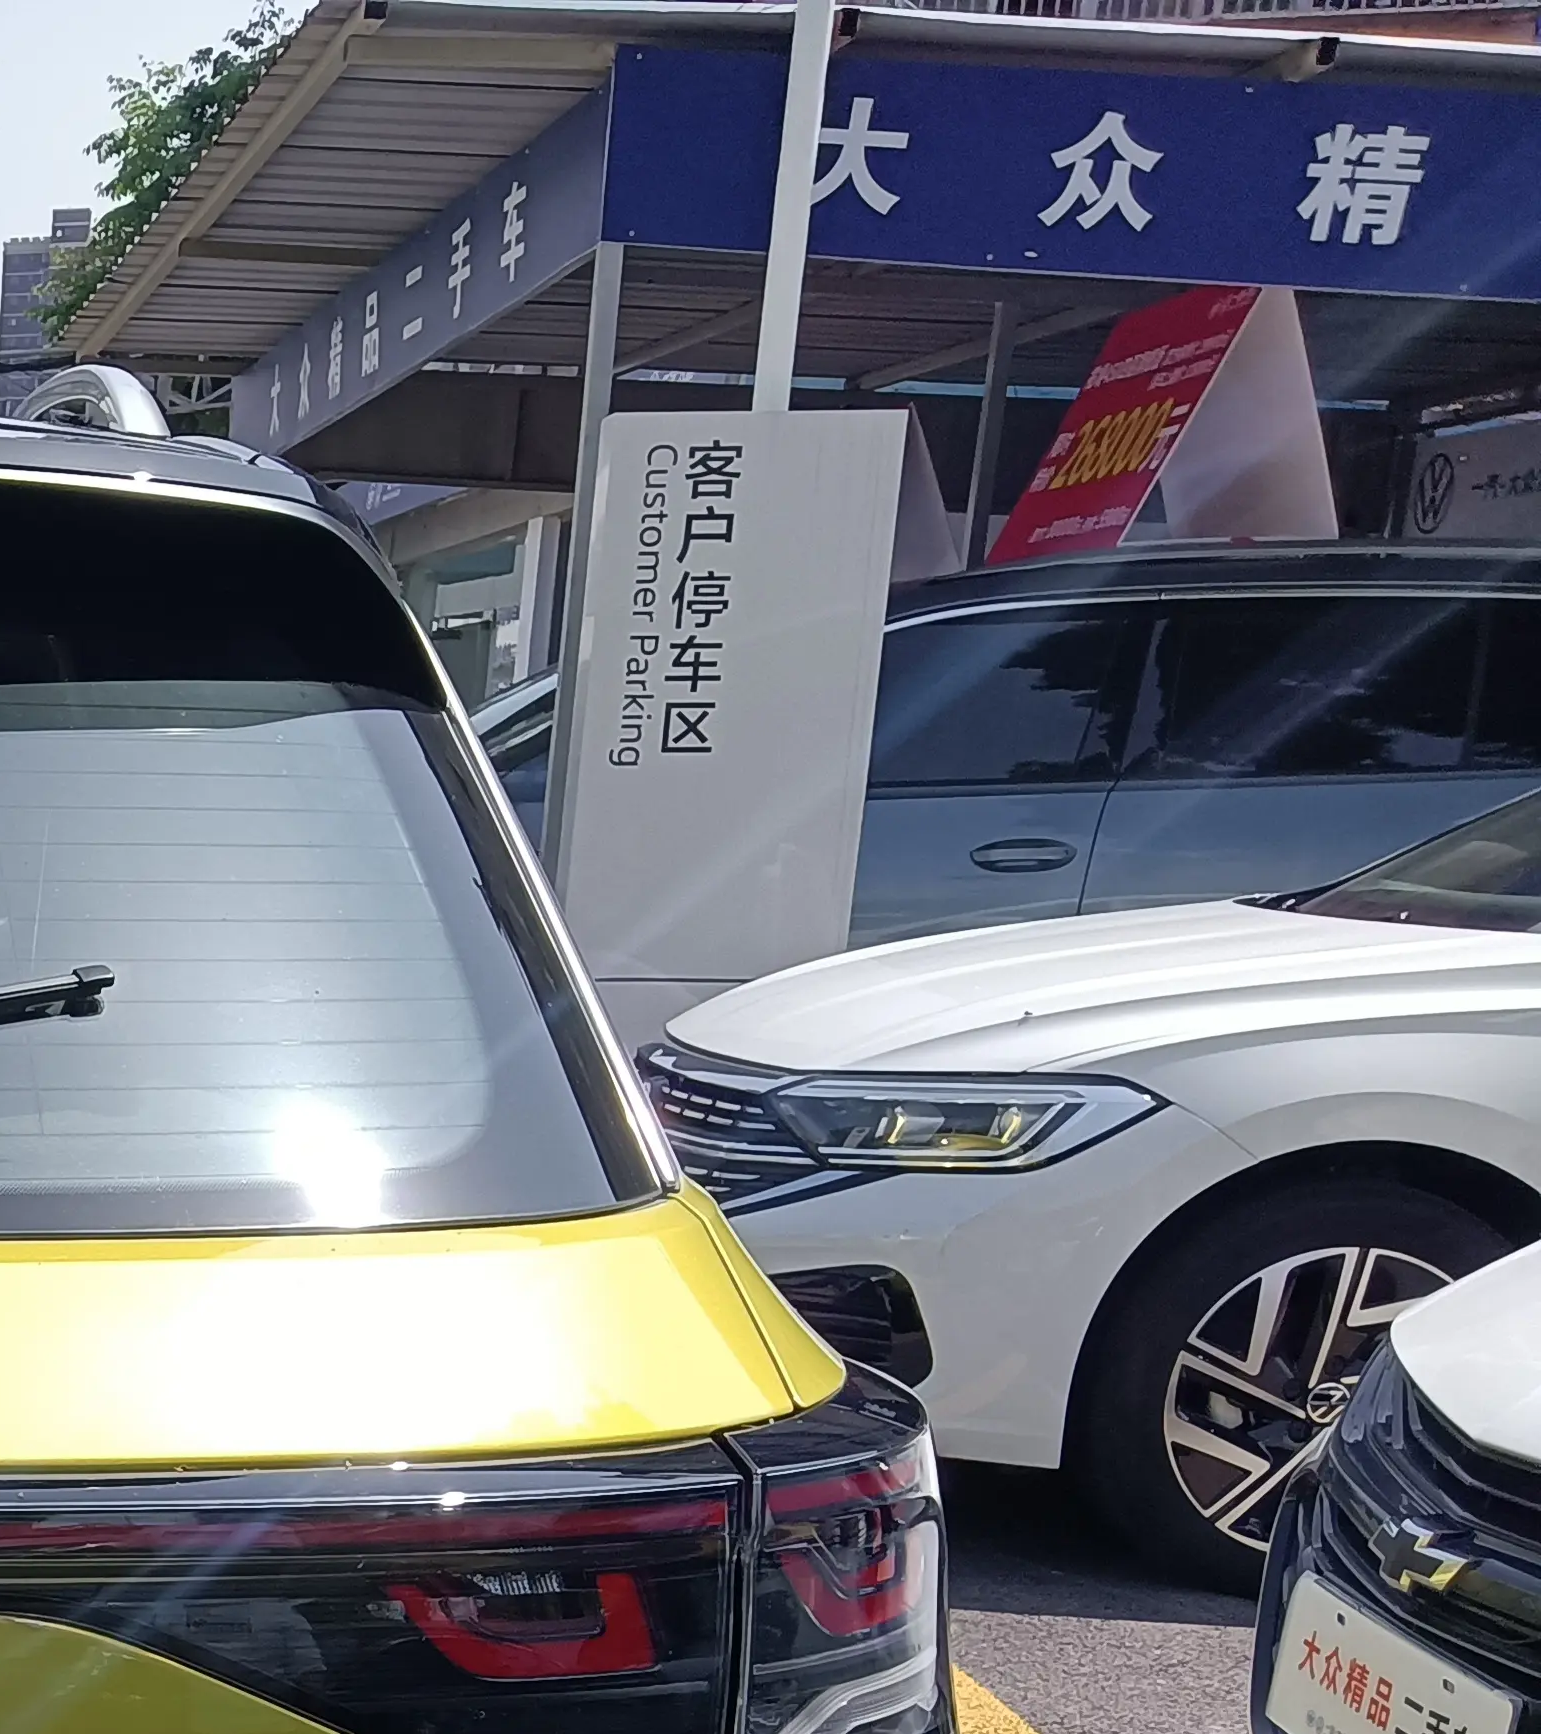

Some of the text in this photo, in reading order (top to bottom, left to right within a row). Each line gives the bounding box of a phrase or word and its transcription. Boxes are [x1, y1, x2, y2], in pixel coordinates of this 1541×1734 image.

[269, 180, 528, 437] 大众精品二手车
[608, 443, 679, 768] Customer Parking
[661, 439, 743, 753] 客户停车区
